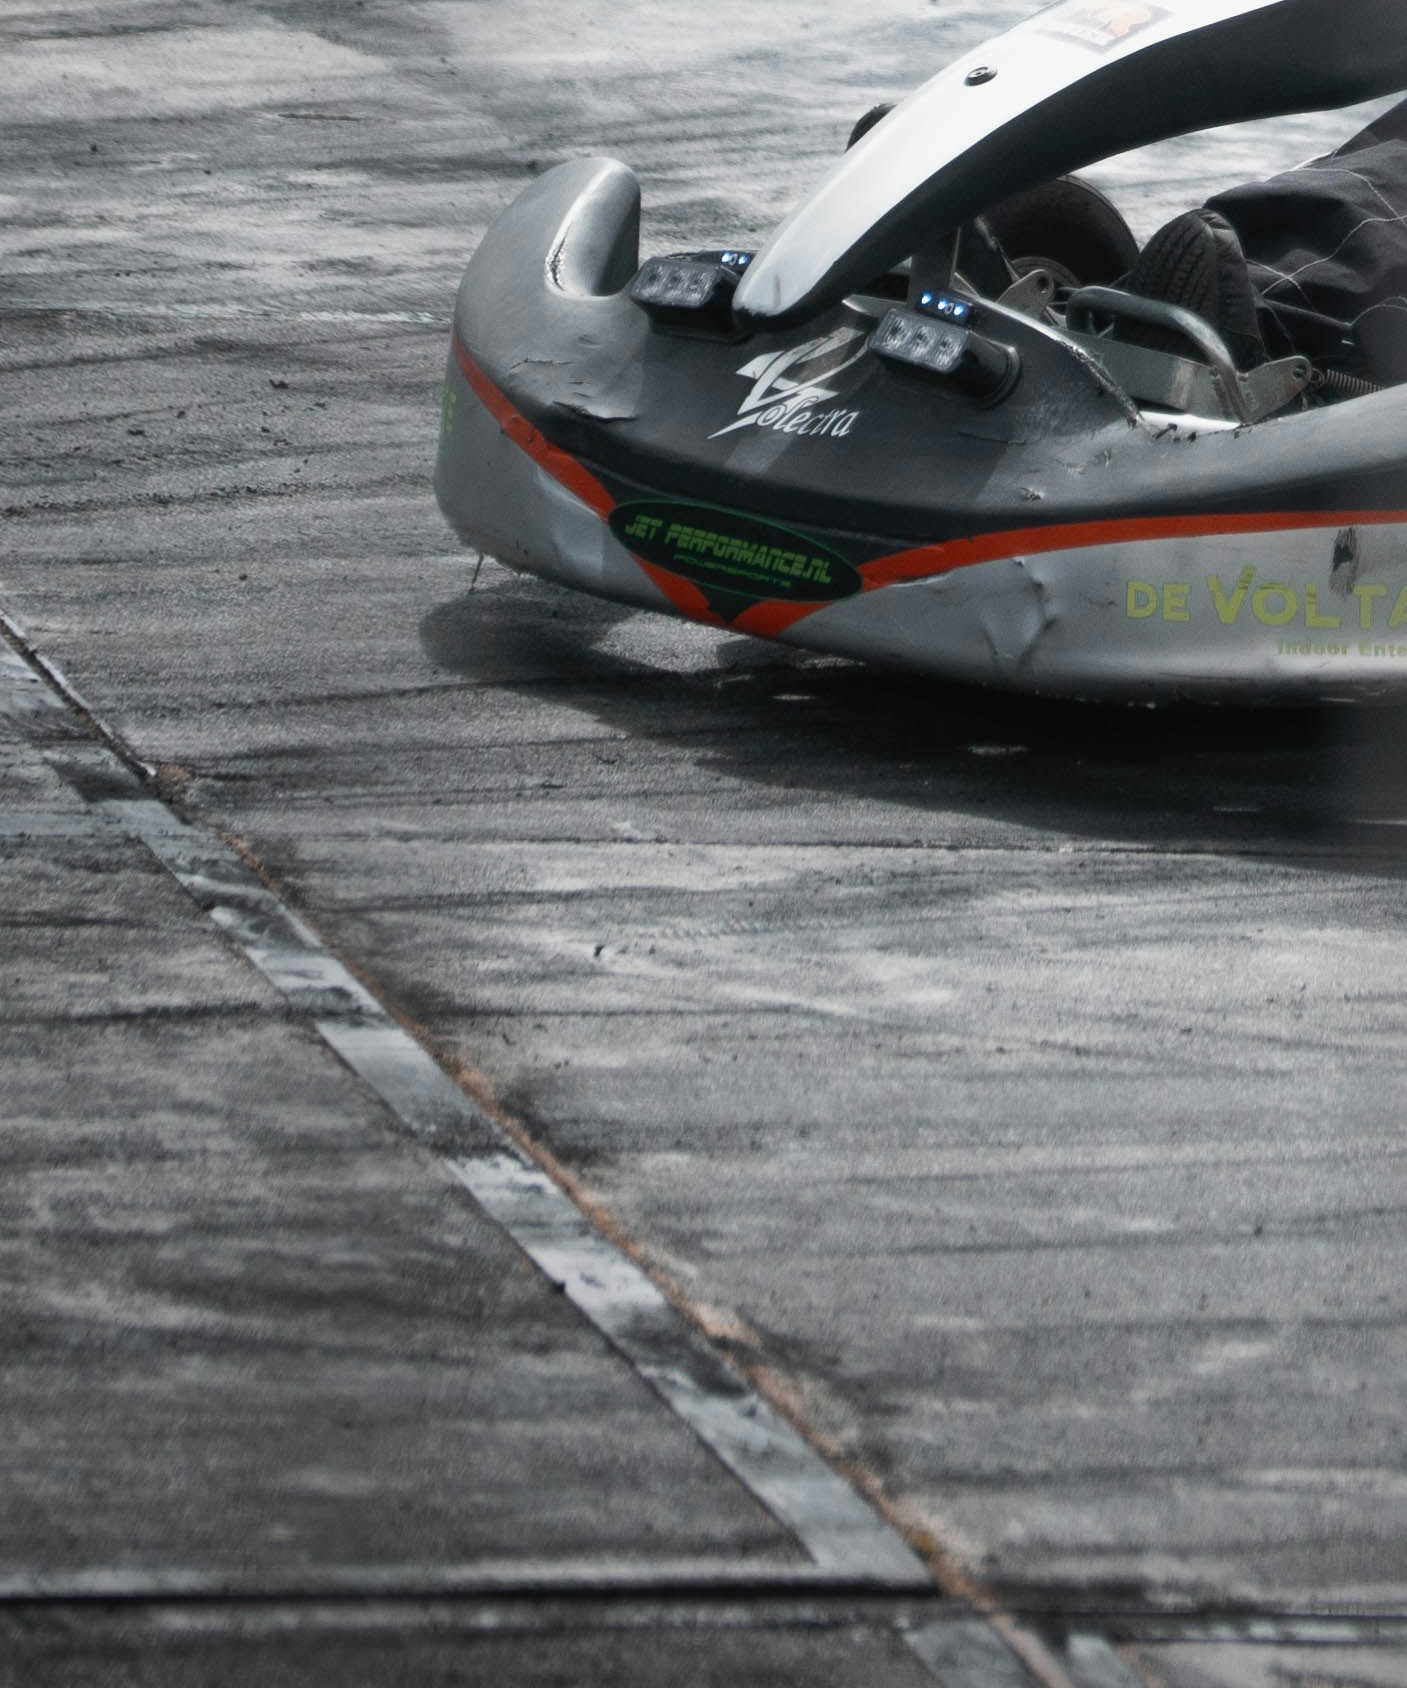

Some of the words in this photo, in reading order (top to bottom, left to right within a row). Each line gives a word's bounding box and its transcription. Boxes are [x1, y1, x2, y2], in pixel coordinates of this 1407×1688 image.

[624, 515, 664, 538] JET
[1126, 581, 1193, 621] DE
[1277, 641, 1349, 656] Indoor
